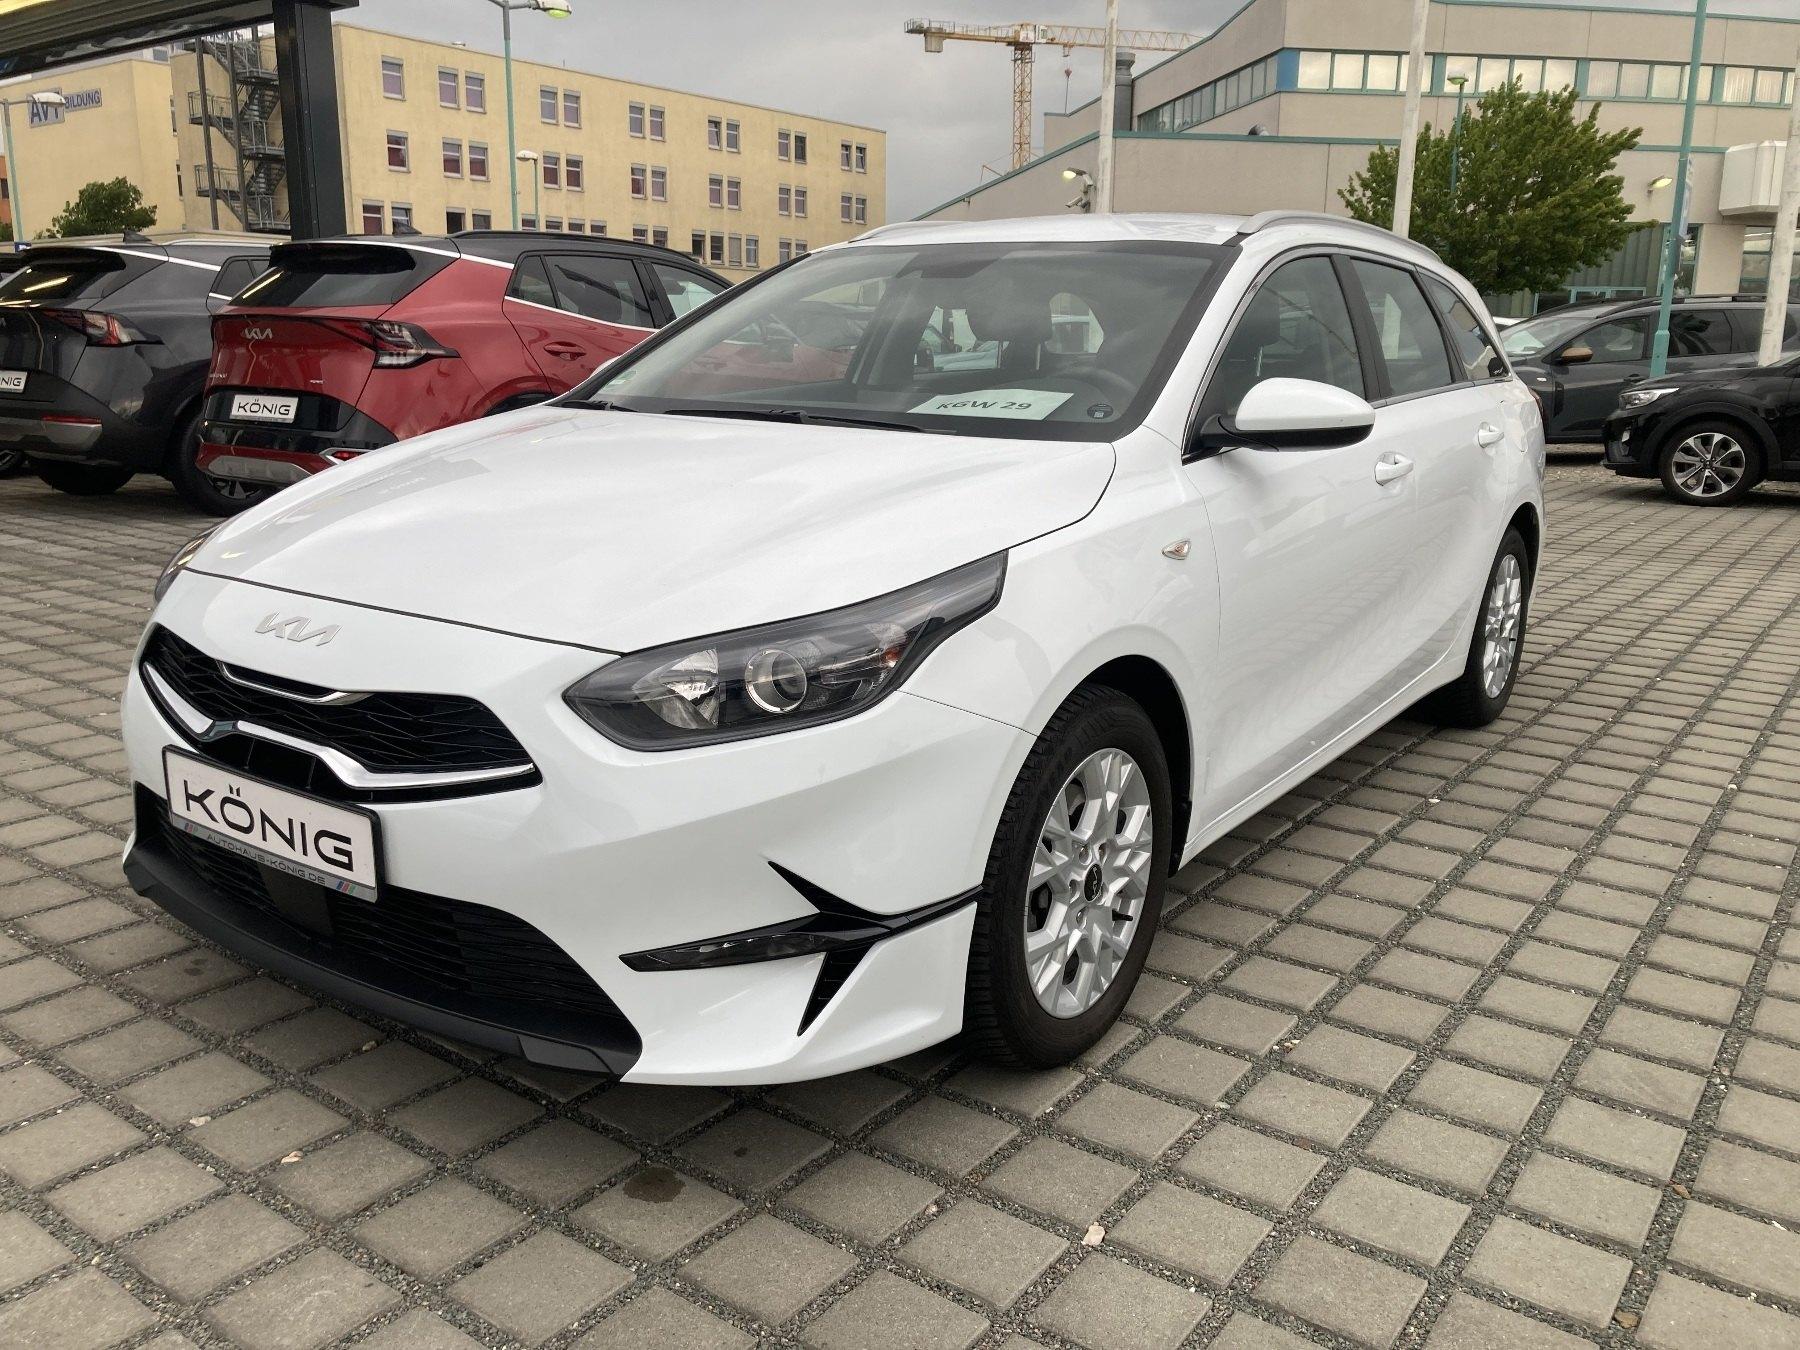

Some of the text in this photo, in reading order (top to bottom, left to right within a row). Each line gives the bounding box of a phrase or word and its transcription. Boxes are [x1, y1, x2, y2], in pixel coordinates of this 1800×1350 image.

[64, 91, 101, 109] BILDUNG
[0, 377, 22, 387] NIG
[237, 398, 291, 416] KÖNIG
[936, 400, 1032, 410] KGW 29
[255, 611, 344, 647] KIA
[183, 779, 354, 872] KÖNIG
